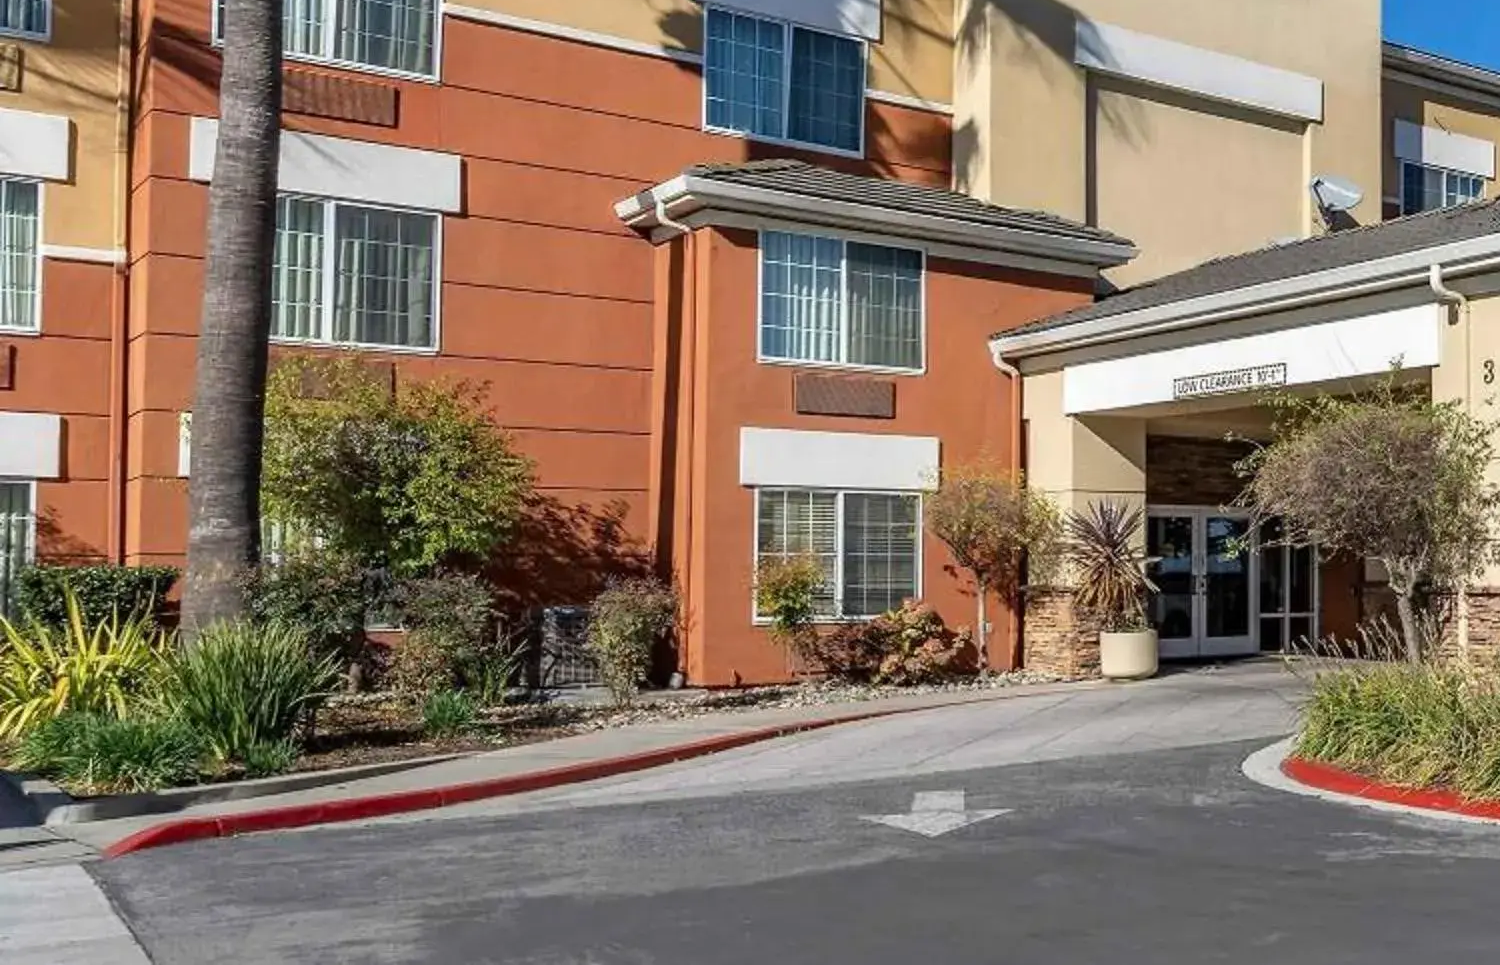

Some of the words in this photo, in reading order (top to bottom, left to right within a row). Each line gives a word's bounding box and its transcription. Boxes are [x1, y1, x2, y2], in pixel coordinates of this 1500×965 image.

[1177, 380, 1198, 394] LOW
[1199, 372, 1252, 391] CLEARANCE
[1483, 359, 1495, 385] 3
